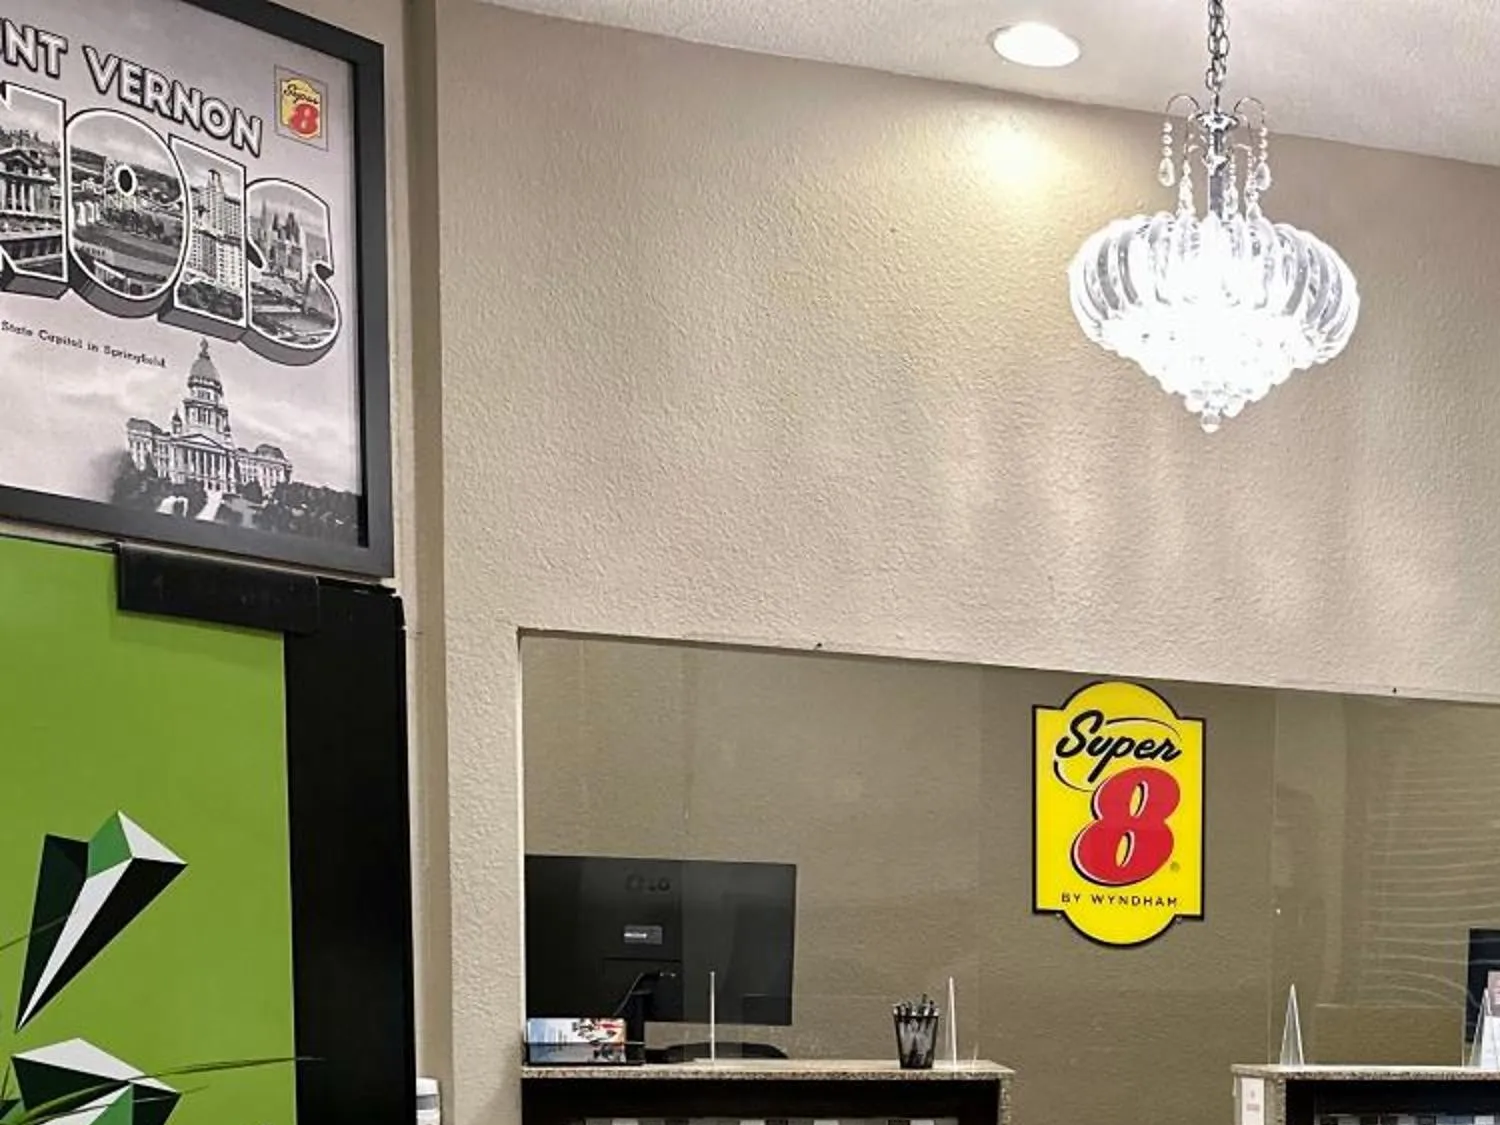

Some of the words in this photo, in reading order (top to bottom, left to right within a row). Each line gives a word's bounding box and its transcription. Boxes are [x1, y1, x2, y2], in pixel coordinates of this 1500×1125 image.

[82, 45, 262, 157] VERNON
[290, 103, 319, 135] 8
[38, 329, 83, 349] Capitol
[87, 342, 99, 353] in
[1055, 709, 1183, 783] Super
[1070, 765, 1182, 888] 8
[1060, 892, 1082, 905] BY
[1091, 894, 1179, 908] WYNDHAM
